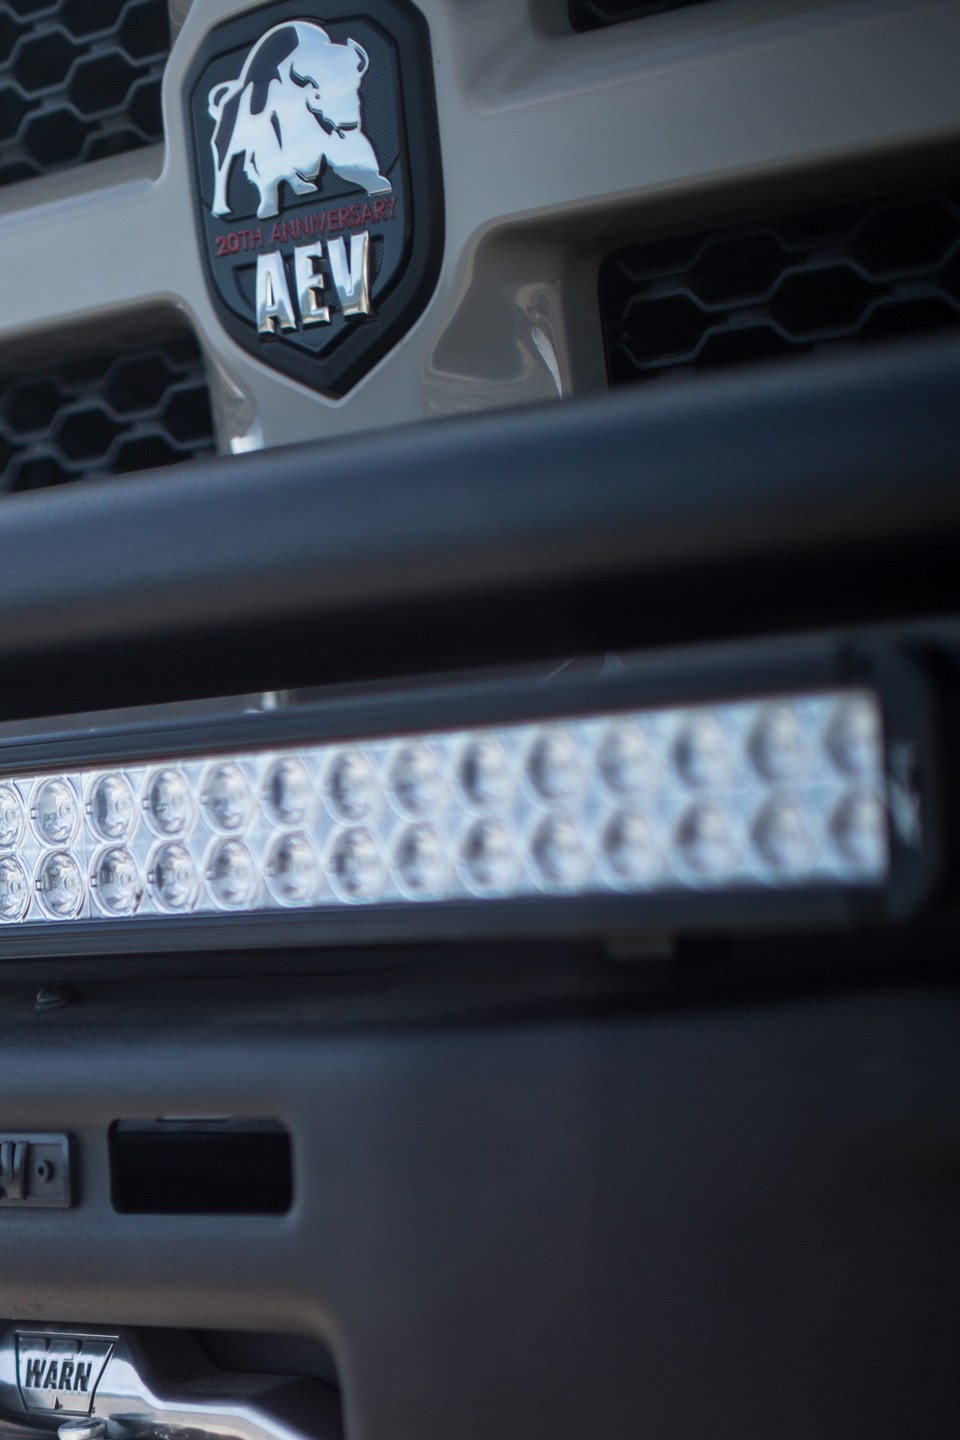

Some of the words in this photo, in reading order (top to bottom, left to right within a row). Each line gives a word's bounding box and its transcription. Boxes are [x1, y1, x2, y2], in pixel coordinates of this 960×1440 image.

[216, 227, 264, 256] 20TH
[270, 197, 397, 244] ANNIVERSARY
[255, 230, 370, 340] AEV
[25, 1358, 93, 1392] WARN
